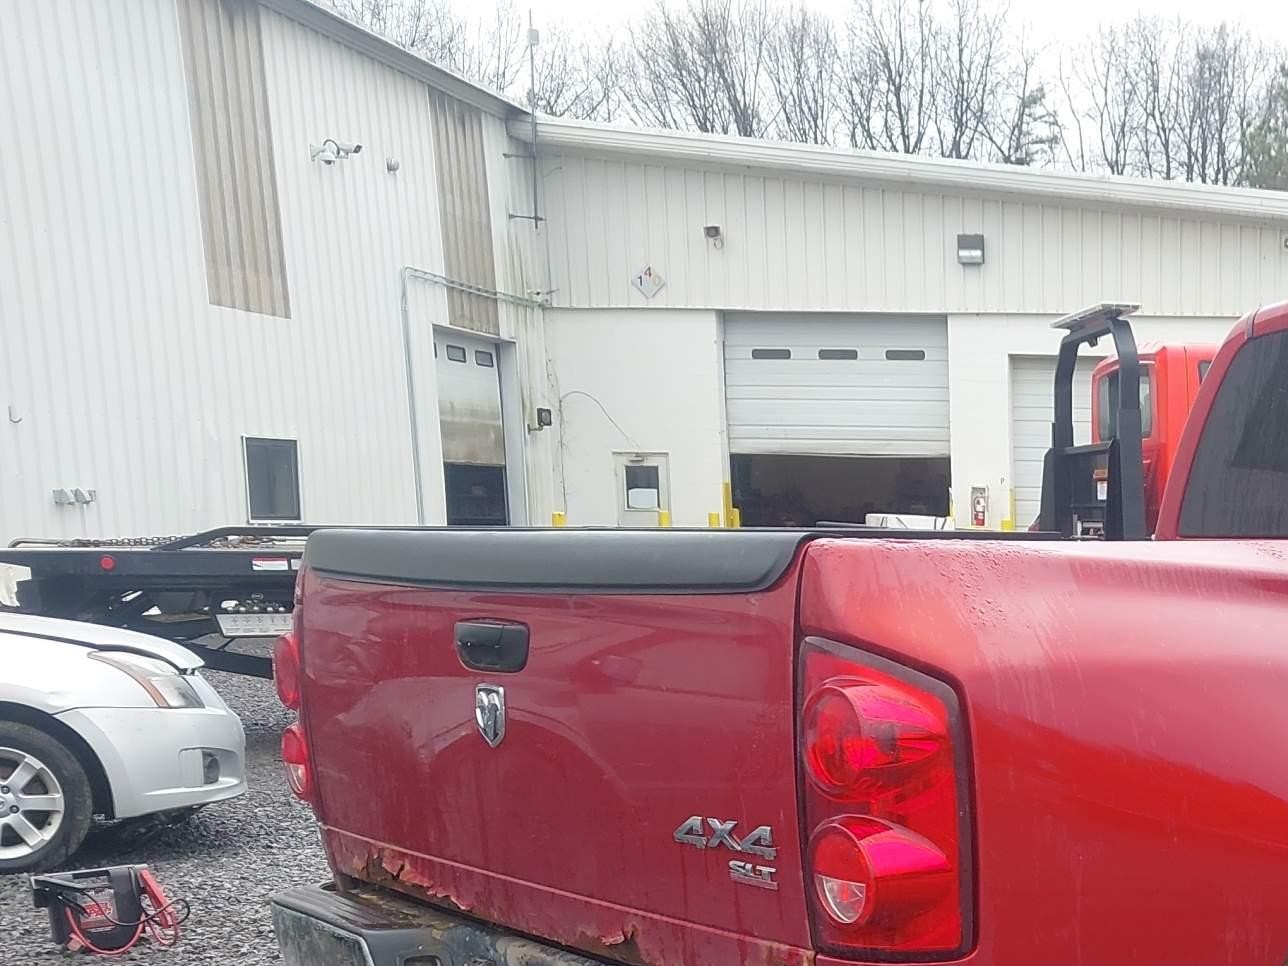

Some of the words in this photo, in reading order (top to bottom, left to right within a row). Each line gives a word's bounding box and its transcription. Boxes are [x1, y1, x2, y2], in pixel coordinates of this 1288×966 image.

[643, 266, 652, 278] 4
[637, 275, 643, 287] 1
[673, 815, 777, 860] 4X4
[729, 860, 777, 883] SLT
